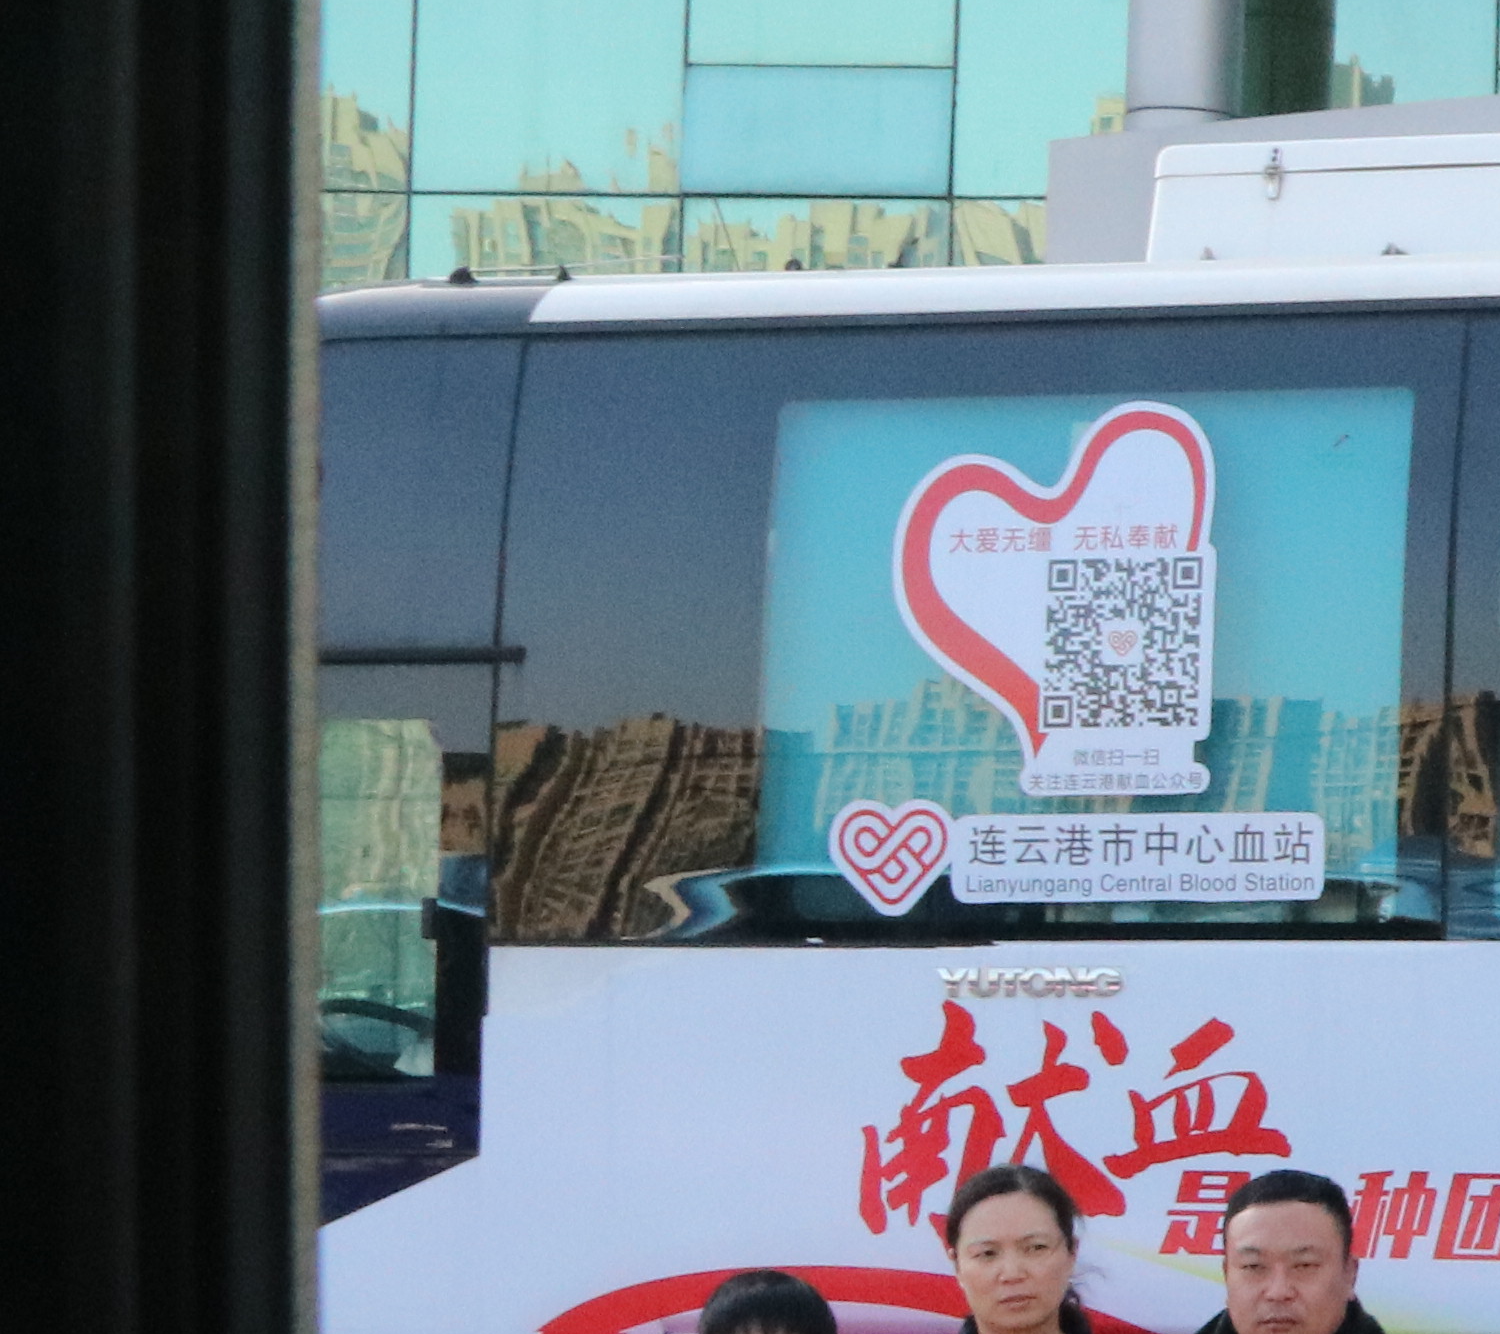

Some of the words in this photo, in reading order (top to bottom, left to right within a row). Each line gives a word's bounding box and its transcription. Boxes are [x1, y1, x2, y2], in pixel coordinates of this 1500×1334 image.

[1073, 524, 1178, 552] 无私奉献
[1073, 748, 1160, 766] 微信扫一扫
[1029, 772, 1203, 791] 关注连云港献血公众号
[968, 821, 1314, 866] 连云港市中心血站
[966, 874, 1093, 897] Lianyungang
[1100, 873, 1172, 893] Central
[1181, 873, 1237, 892] Blood
[1245, 872, 1315, 892] Station
[937, 967, 1126, 998] YUTONG
[858, 999, 1292, 1253] 献血
